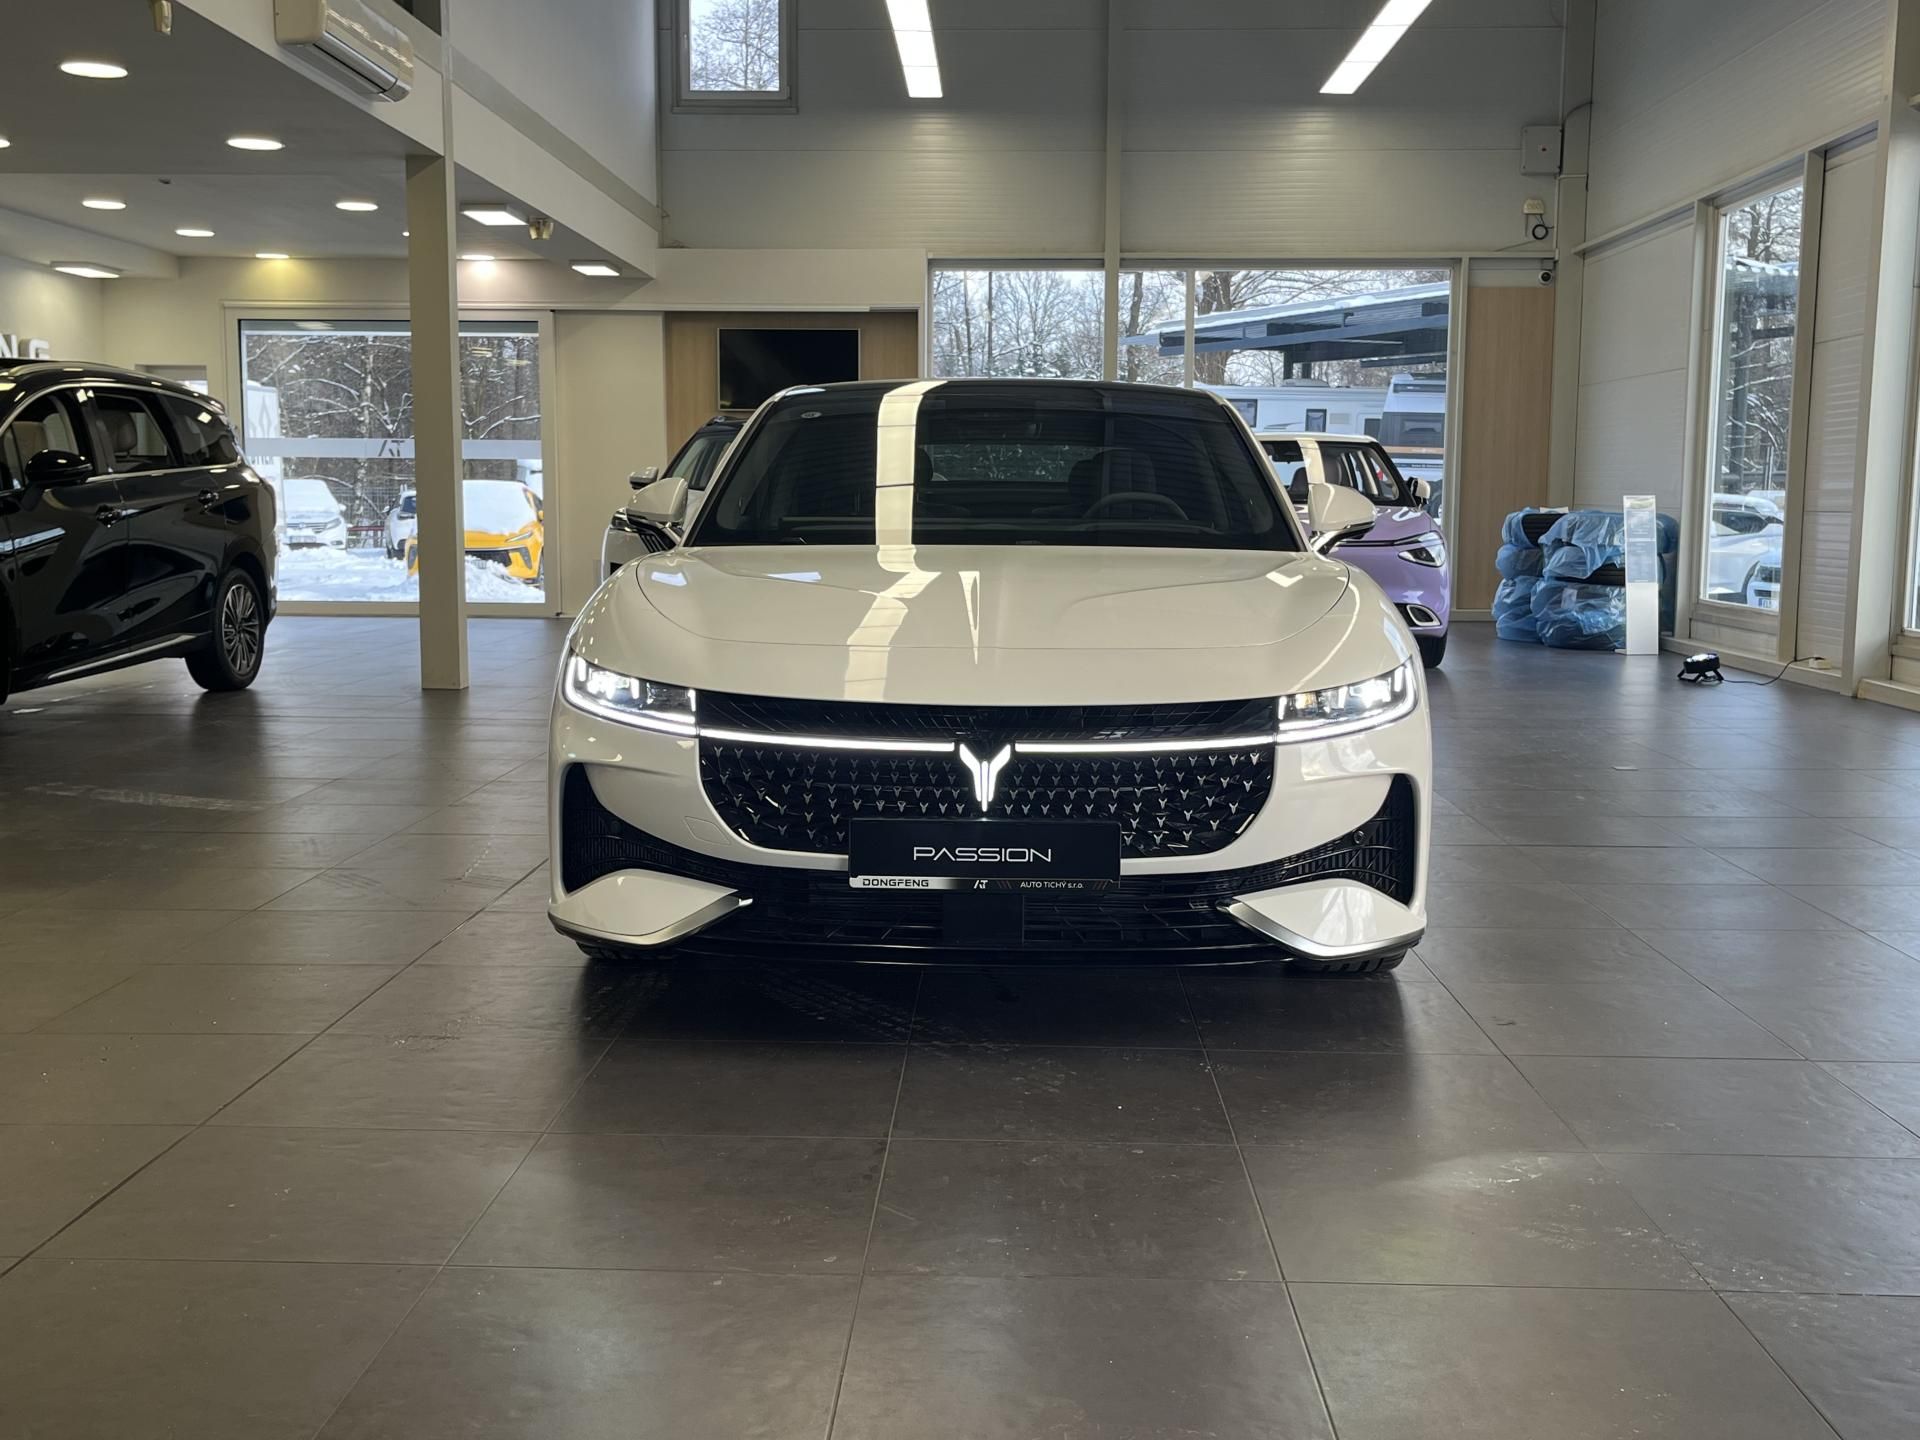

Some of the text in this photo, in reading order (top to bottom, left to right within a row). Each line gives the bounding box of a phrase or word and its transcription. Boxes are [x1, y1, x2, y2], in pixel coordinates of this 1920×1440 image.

[913, 846, 1052, 862] PASSION
[862, 878, 929, 887] DONGFENG
[1020, 881, 1042, 889] AUTO
[1043, 880, 1067, 889] TICHÝ
